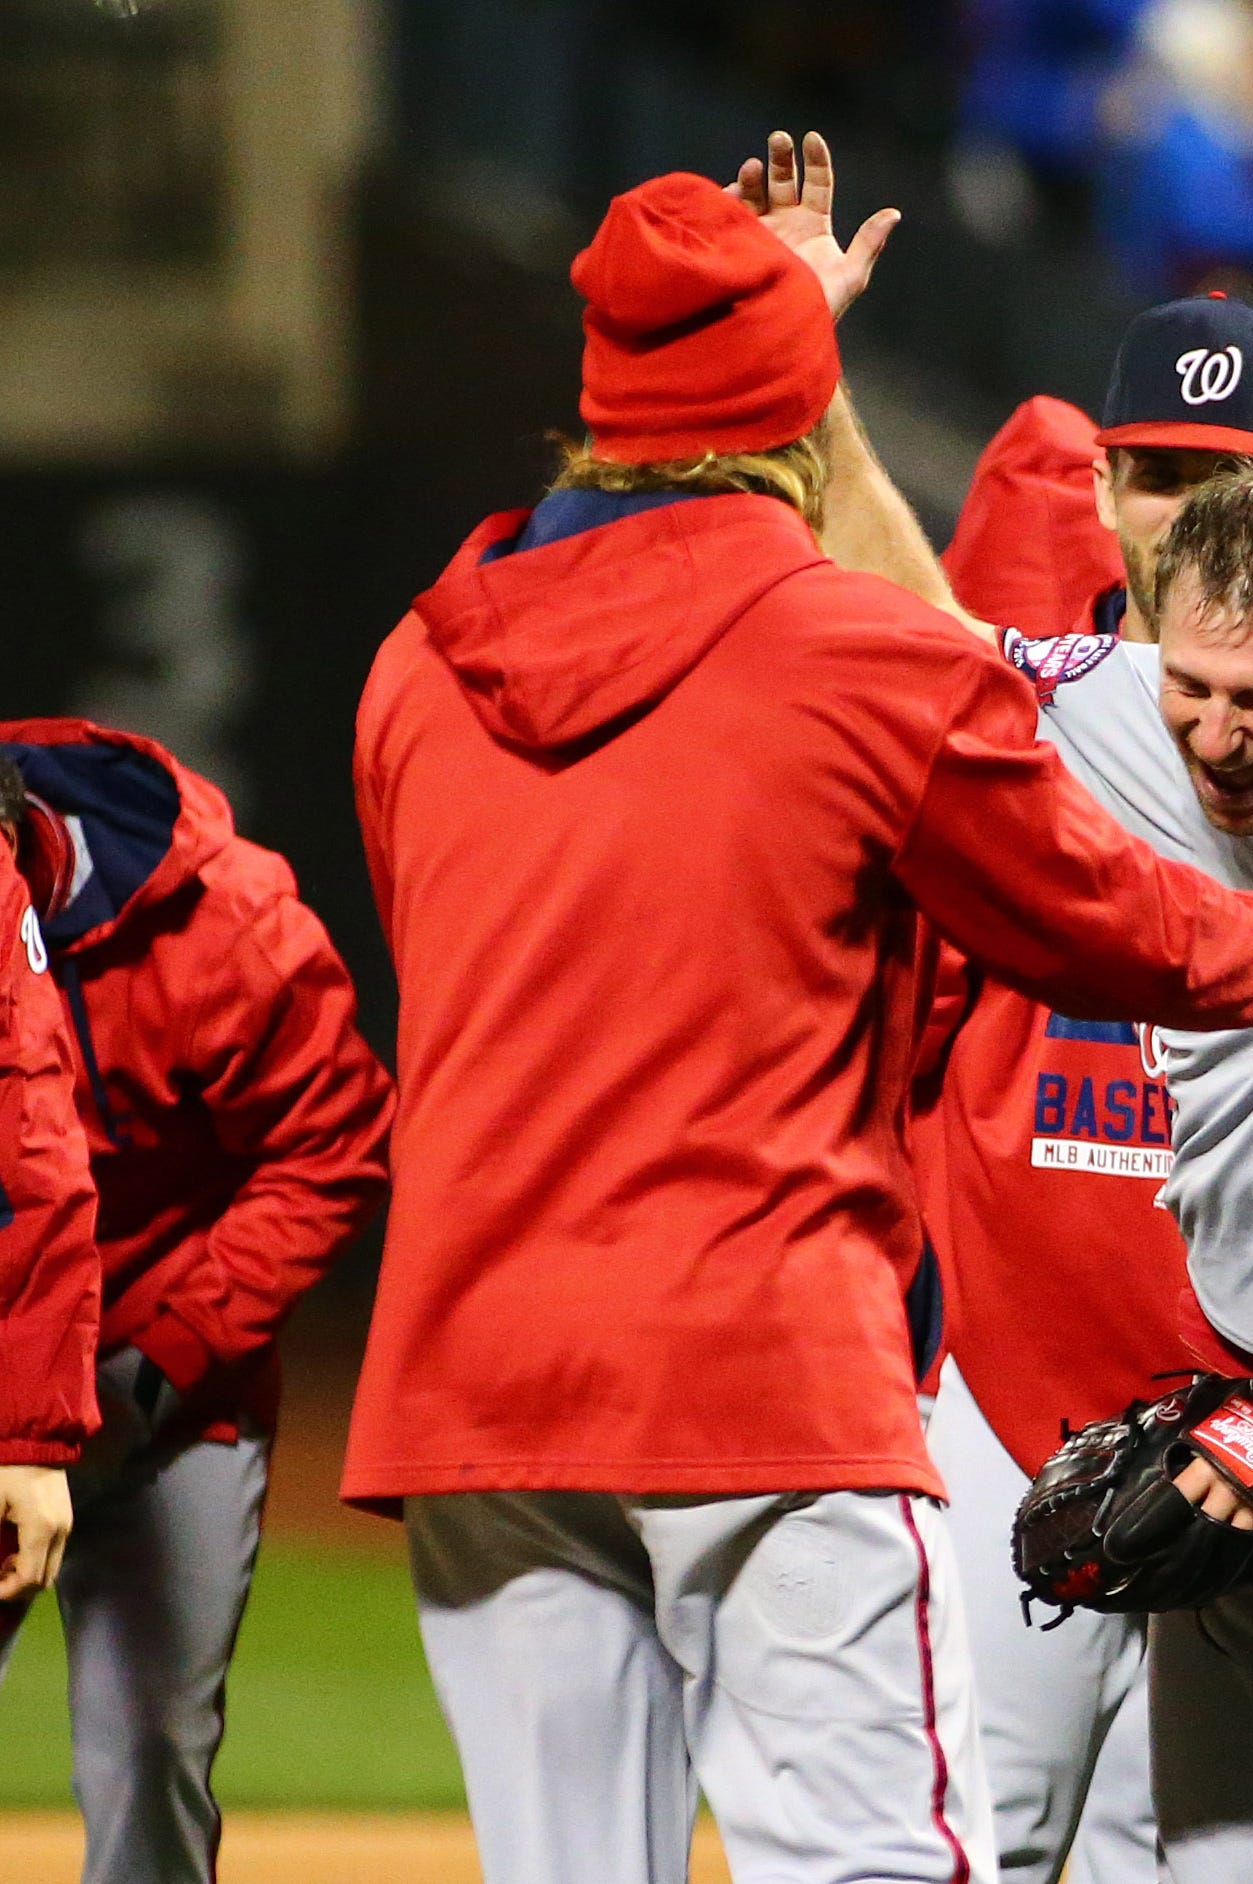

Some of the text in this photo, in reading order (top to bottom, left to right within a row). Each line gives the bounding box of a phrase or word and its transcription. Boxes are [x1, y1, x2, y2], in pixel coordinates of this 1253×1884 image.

[1175, 345, 1242, 405] W
[1034, 1071, 1172, 1146] BASE
[1043, 1143, 1078, 1165] MLB
